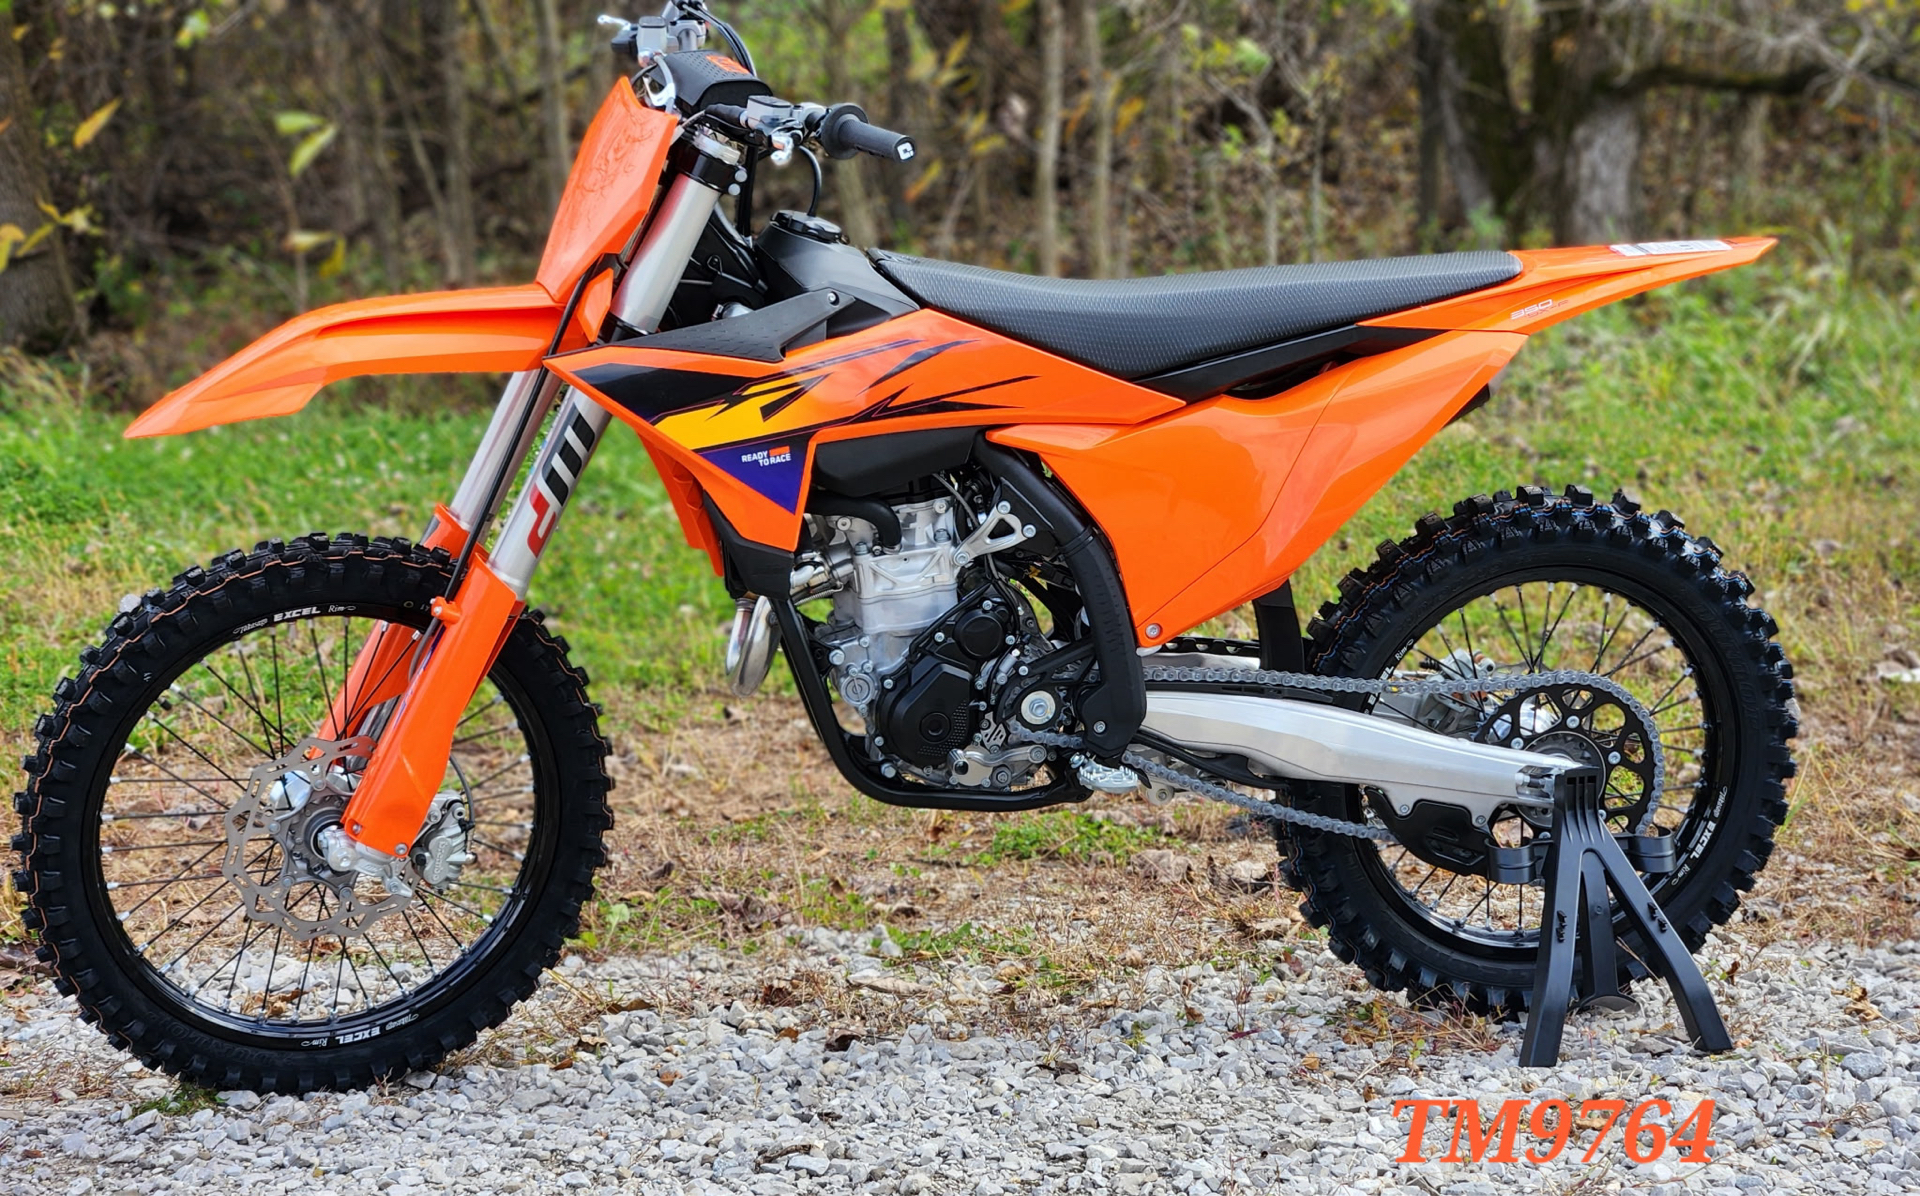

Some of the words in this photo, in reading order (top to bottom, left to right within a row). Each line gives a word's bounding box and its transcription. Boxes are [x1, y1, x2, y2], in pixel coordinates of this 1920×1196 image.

[1510, 298, 1553, 320] 350
[741, 450, 768, 463] READY
[758, 458, 769, 467] TO
[770, 453, 791, 465] RACE
[273, 606, 321, 622] EXCEL
[1690, 820, 1717, 859] EXCEL
[335, 1026, 381, 1045] EXCEL
